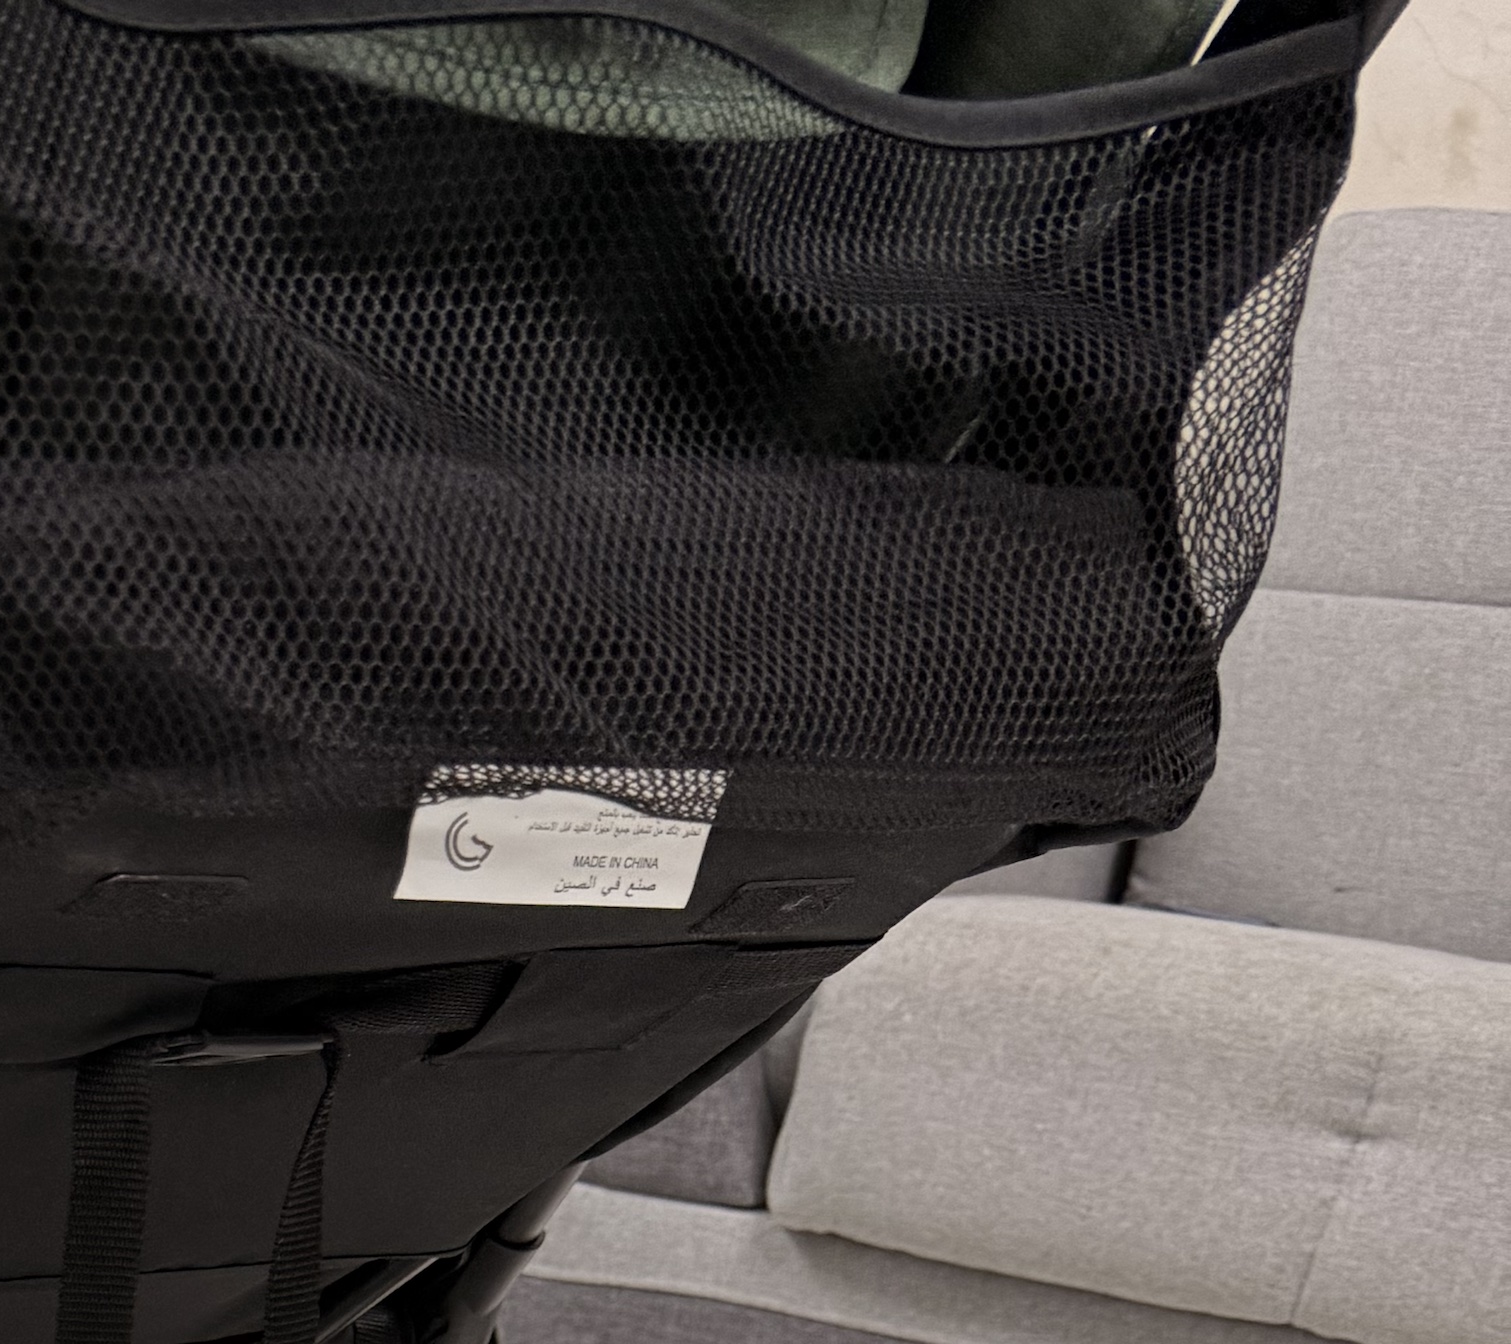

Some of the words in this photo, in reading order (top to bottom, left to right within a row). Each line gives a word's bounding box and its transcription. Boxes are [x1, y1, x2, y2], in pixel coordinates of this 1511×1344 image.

[573, 855, 607, 868] MADE
[609, 856, 622, 869] IN
[623, 857, 658, 869] CHINA
[554, 875, 597, 894] الصين
[601, 876, 621, 897] في
[625, 878, 656, 897] صنع
